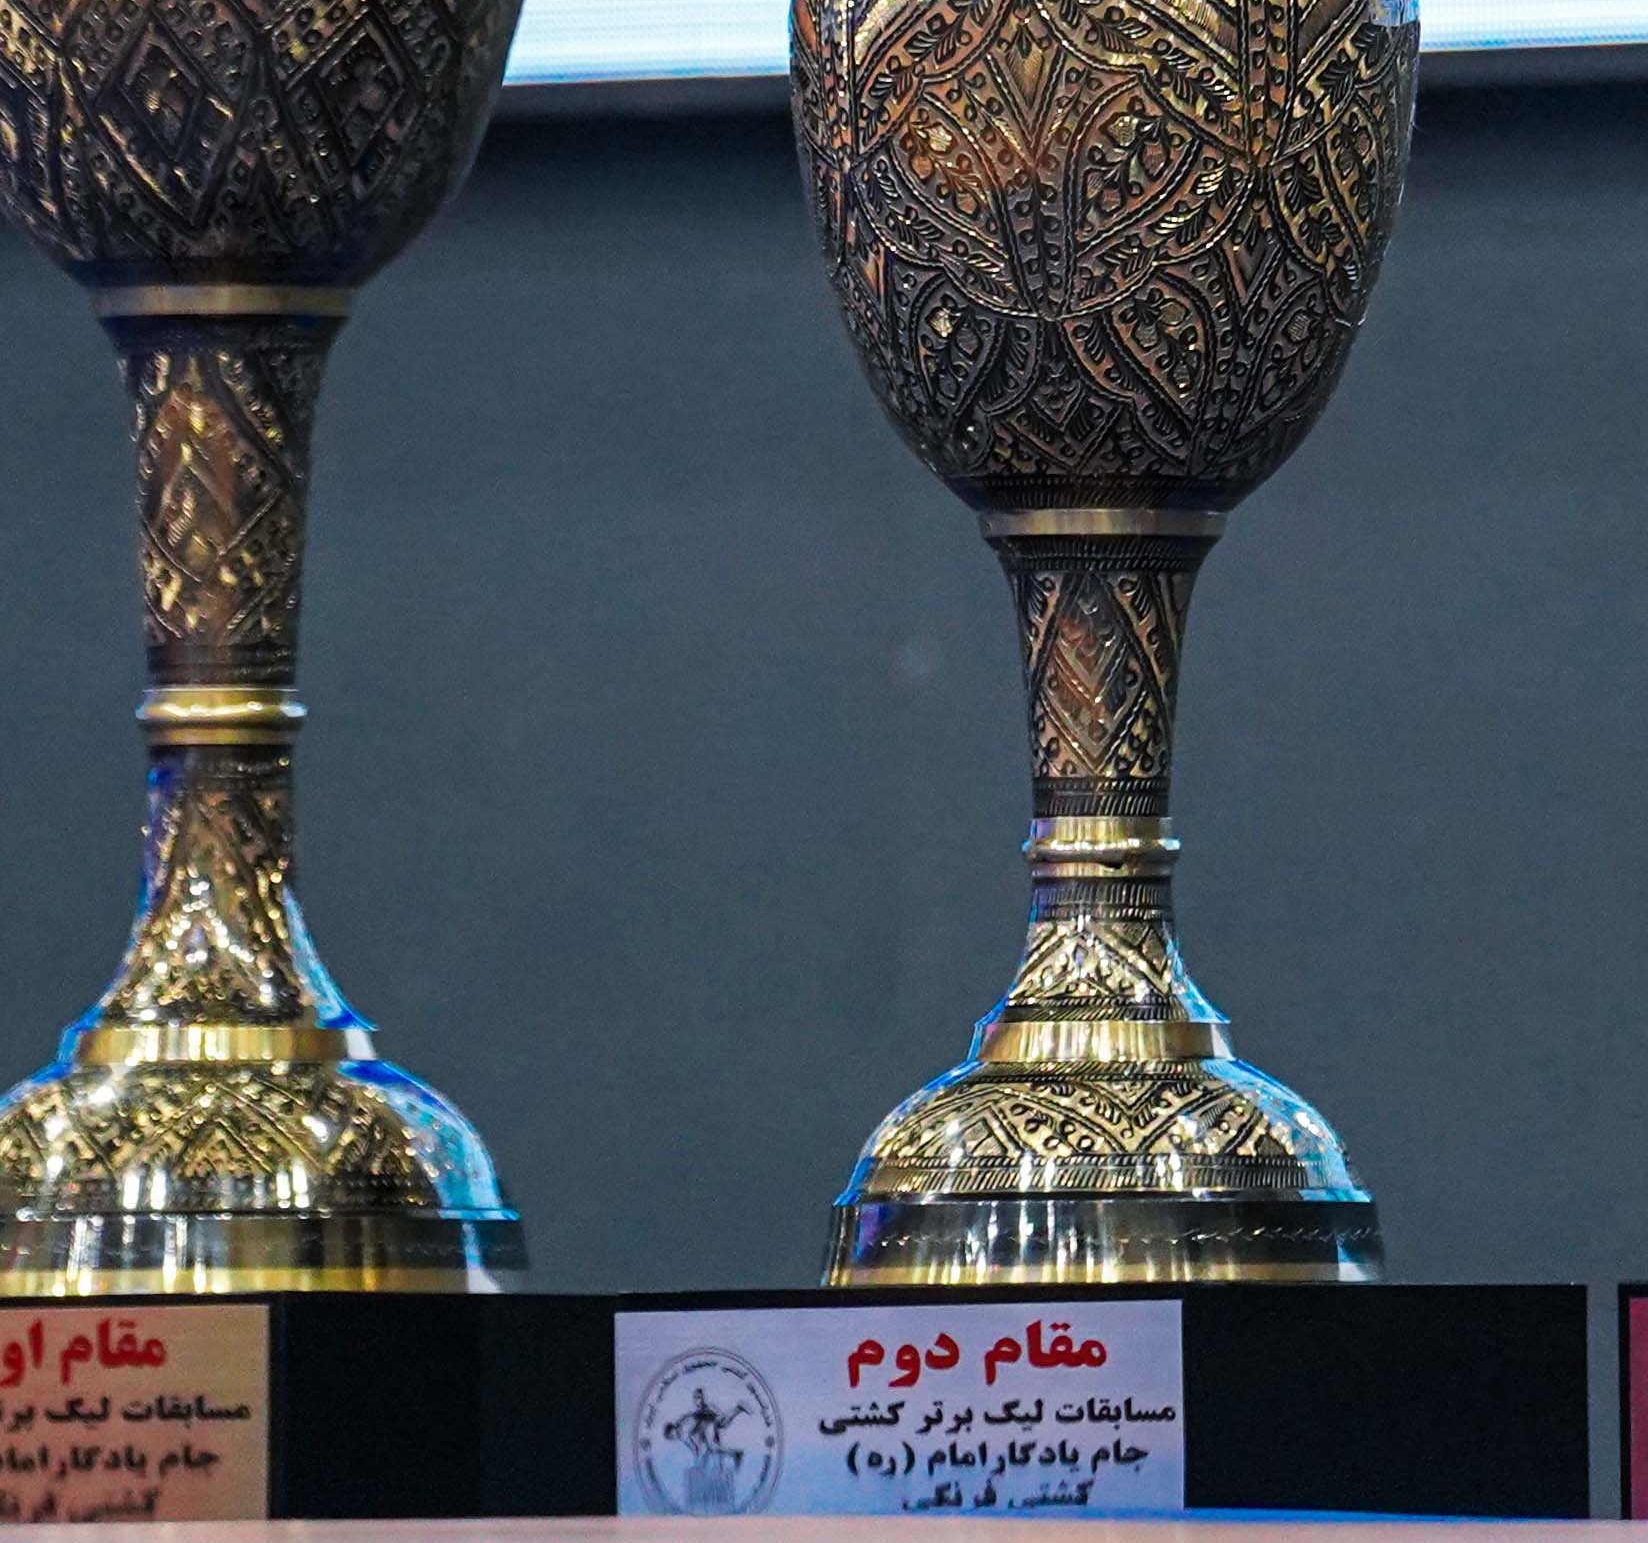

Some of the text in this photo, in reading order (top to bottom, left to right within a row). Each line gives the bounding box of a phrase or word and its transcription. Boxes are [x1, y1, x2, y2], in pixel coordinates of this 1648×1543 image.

[59, 1319, 167, 1385] مقام
[848, 1320, 1107, 1388] مقام دوم
[121, 1396, 251, 1427] مسابقات
[819, 1397, 1176, 1435] مسابقات لیگ برتر کشتی
[158, 1446, 221, 1478] جام
[928, 1441, 986, 1476] امام
[990, 1440, 1079, 1475] یادگار
[1090, 1440, 1149, 1473] جام
